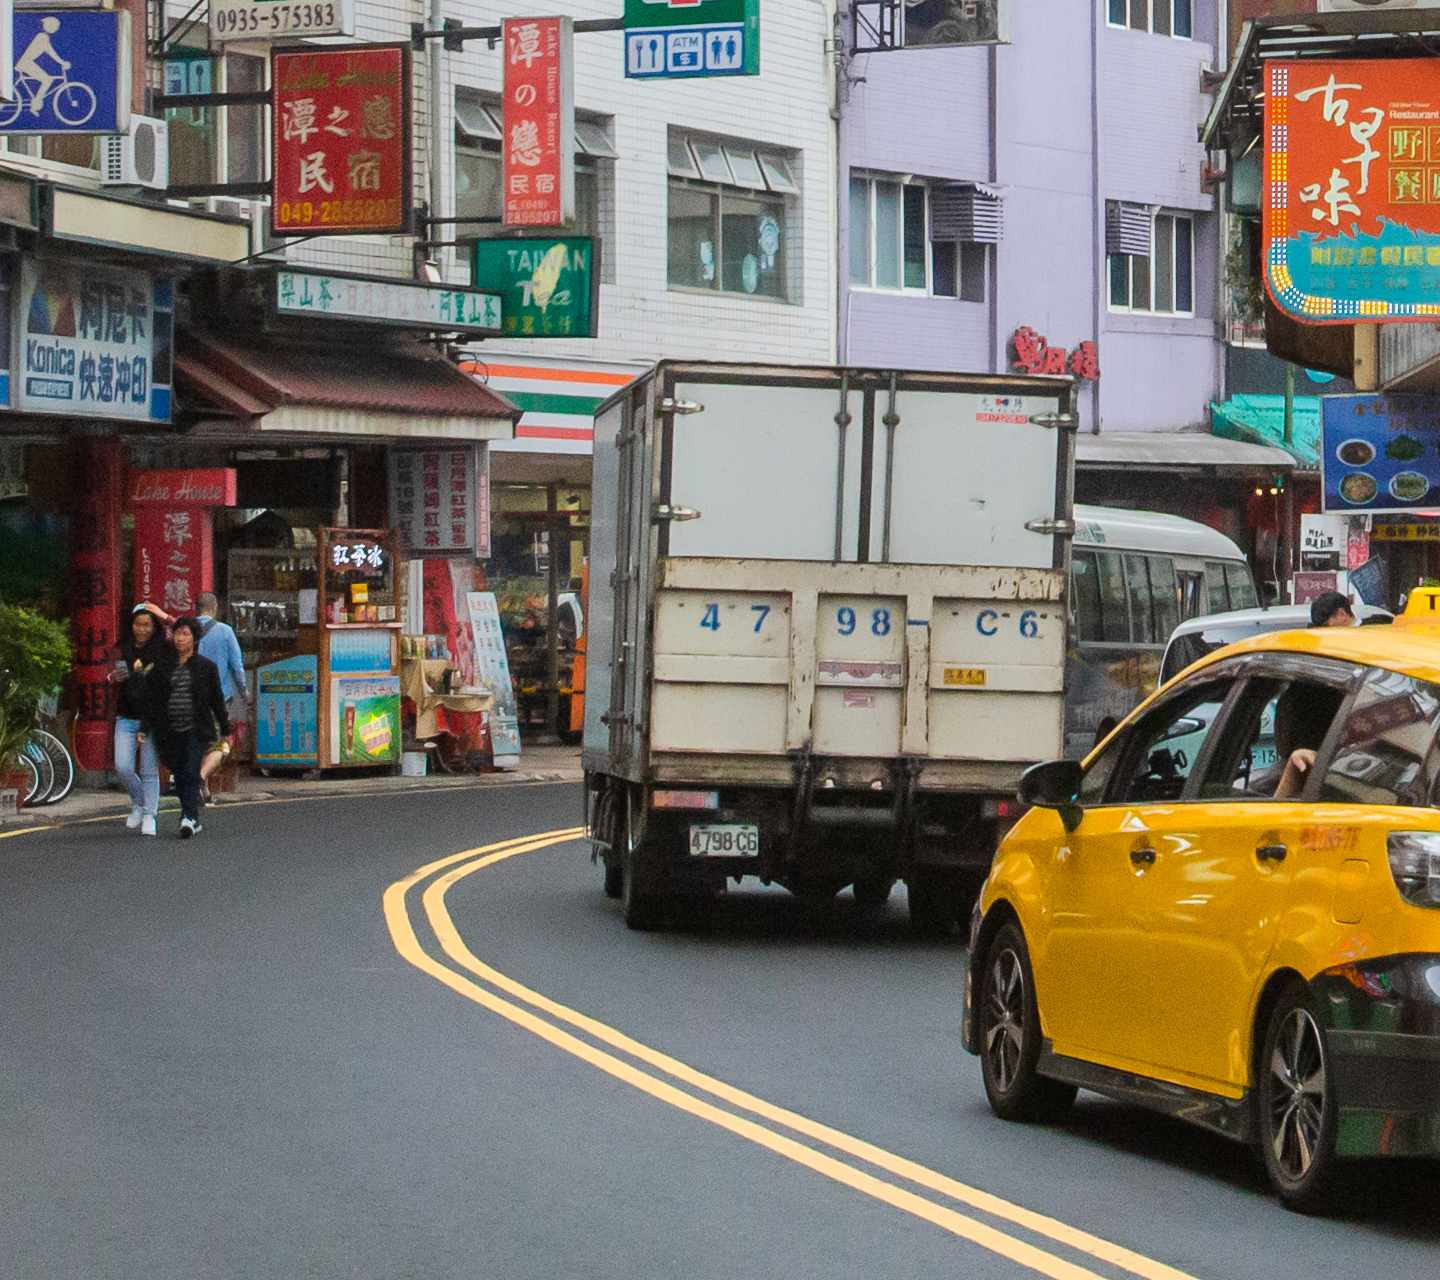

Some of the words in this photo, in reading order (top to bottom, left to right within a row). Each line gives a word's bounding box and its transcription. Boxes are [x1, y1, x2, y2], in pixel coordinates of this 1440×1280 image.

[217, 3, 336, 33] 0935-575383
[672, 36, 700, 49] ATM
[299, 151, 382, 193] 民宿
[26, 339, 76, 375] Konica
